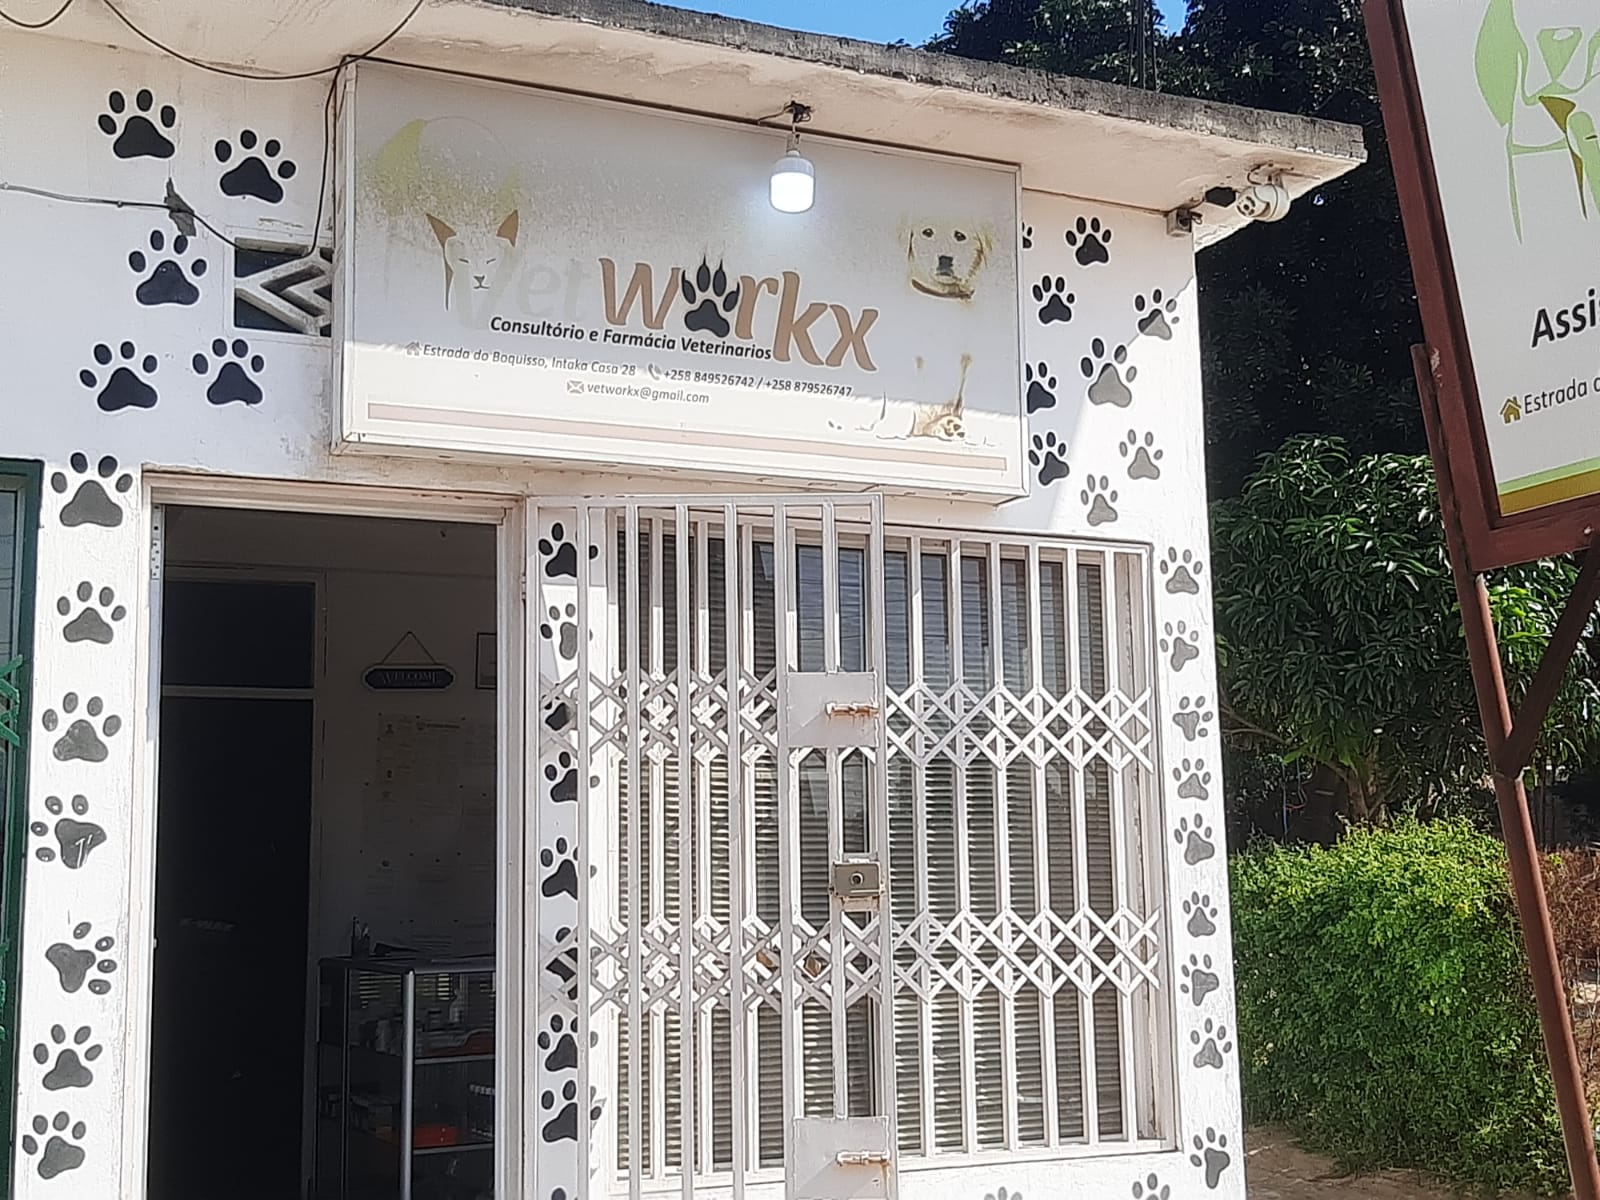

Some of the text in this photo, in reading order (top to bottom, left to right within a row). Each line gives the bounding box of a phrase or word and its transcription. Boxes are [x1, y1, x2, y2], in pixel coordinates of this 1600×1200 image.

[490, 316, 772, 360] Consultório e Farmácia Veterinarios
[1532, 288, 1600, 348] Assi
[423, 344, 470, 359] Estrada
[473, 349, 489, 361] do
[492, 351, 548, 368] Boquisso,
[552, 357, 587, 371] Intaka
[591, 361, 618, 374] Casa
[621, 364, 636, 376] 28
[664, 369, 691, 381] +258
[794, 381, 852, 397] 879526747
[587, 383, 709, 403] vetworkx@gmail.com
[1524, 378, 1588, 414] Estrada
